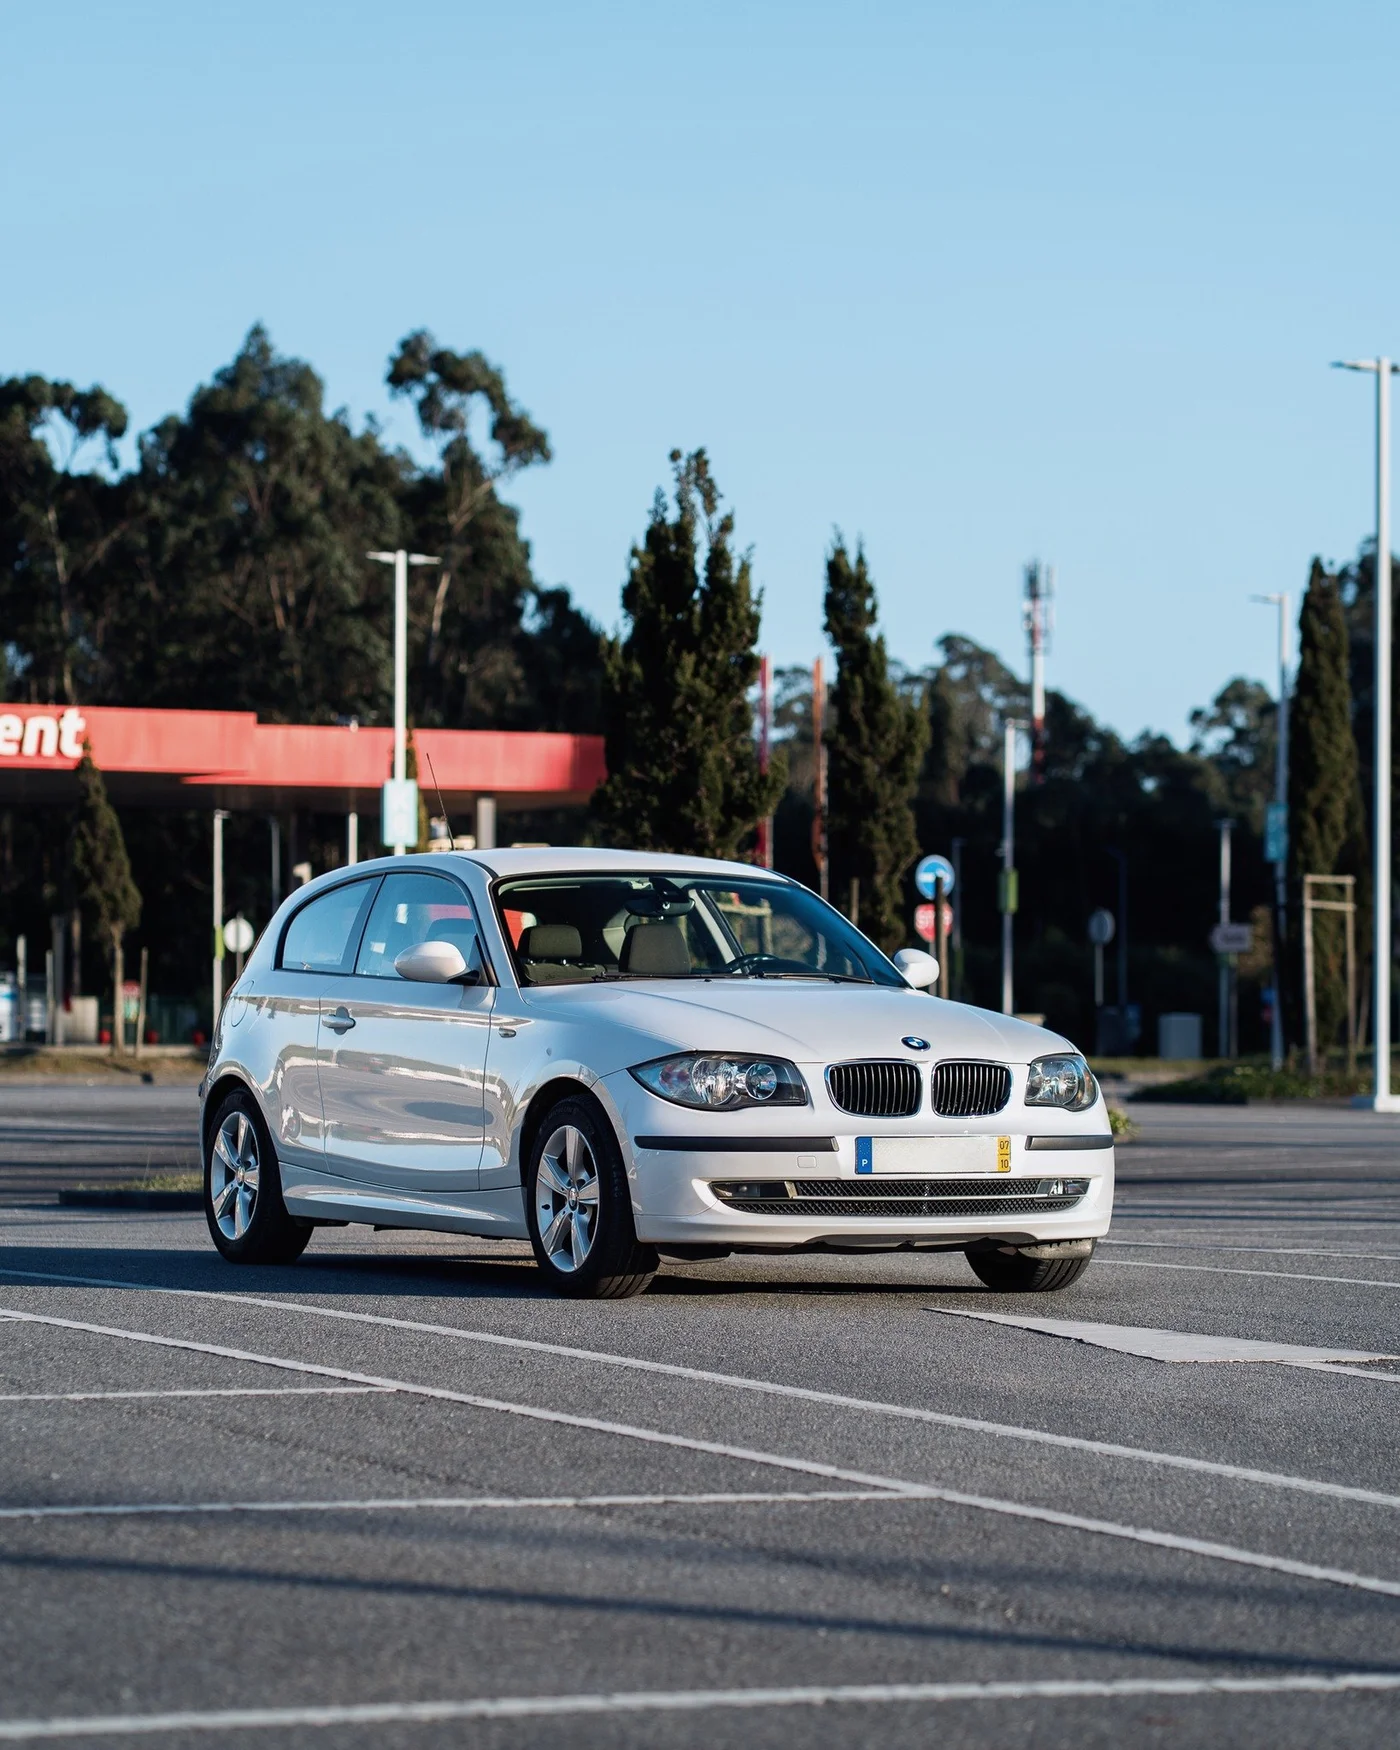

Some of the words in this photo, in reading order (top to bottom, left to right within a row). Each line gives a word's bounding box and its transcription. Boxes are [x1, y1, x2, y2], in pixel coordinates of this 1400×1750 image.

[0, 707, 86, 759] ent
[1000, 1140, 1009, 1150] 07
[861, 1158, 868, 1167] P
[1001, 1159, 1009, 1168] 10
